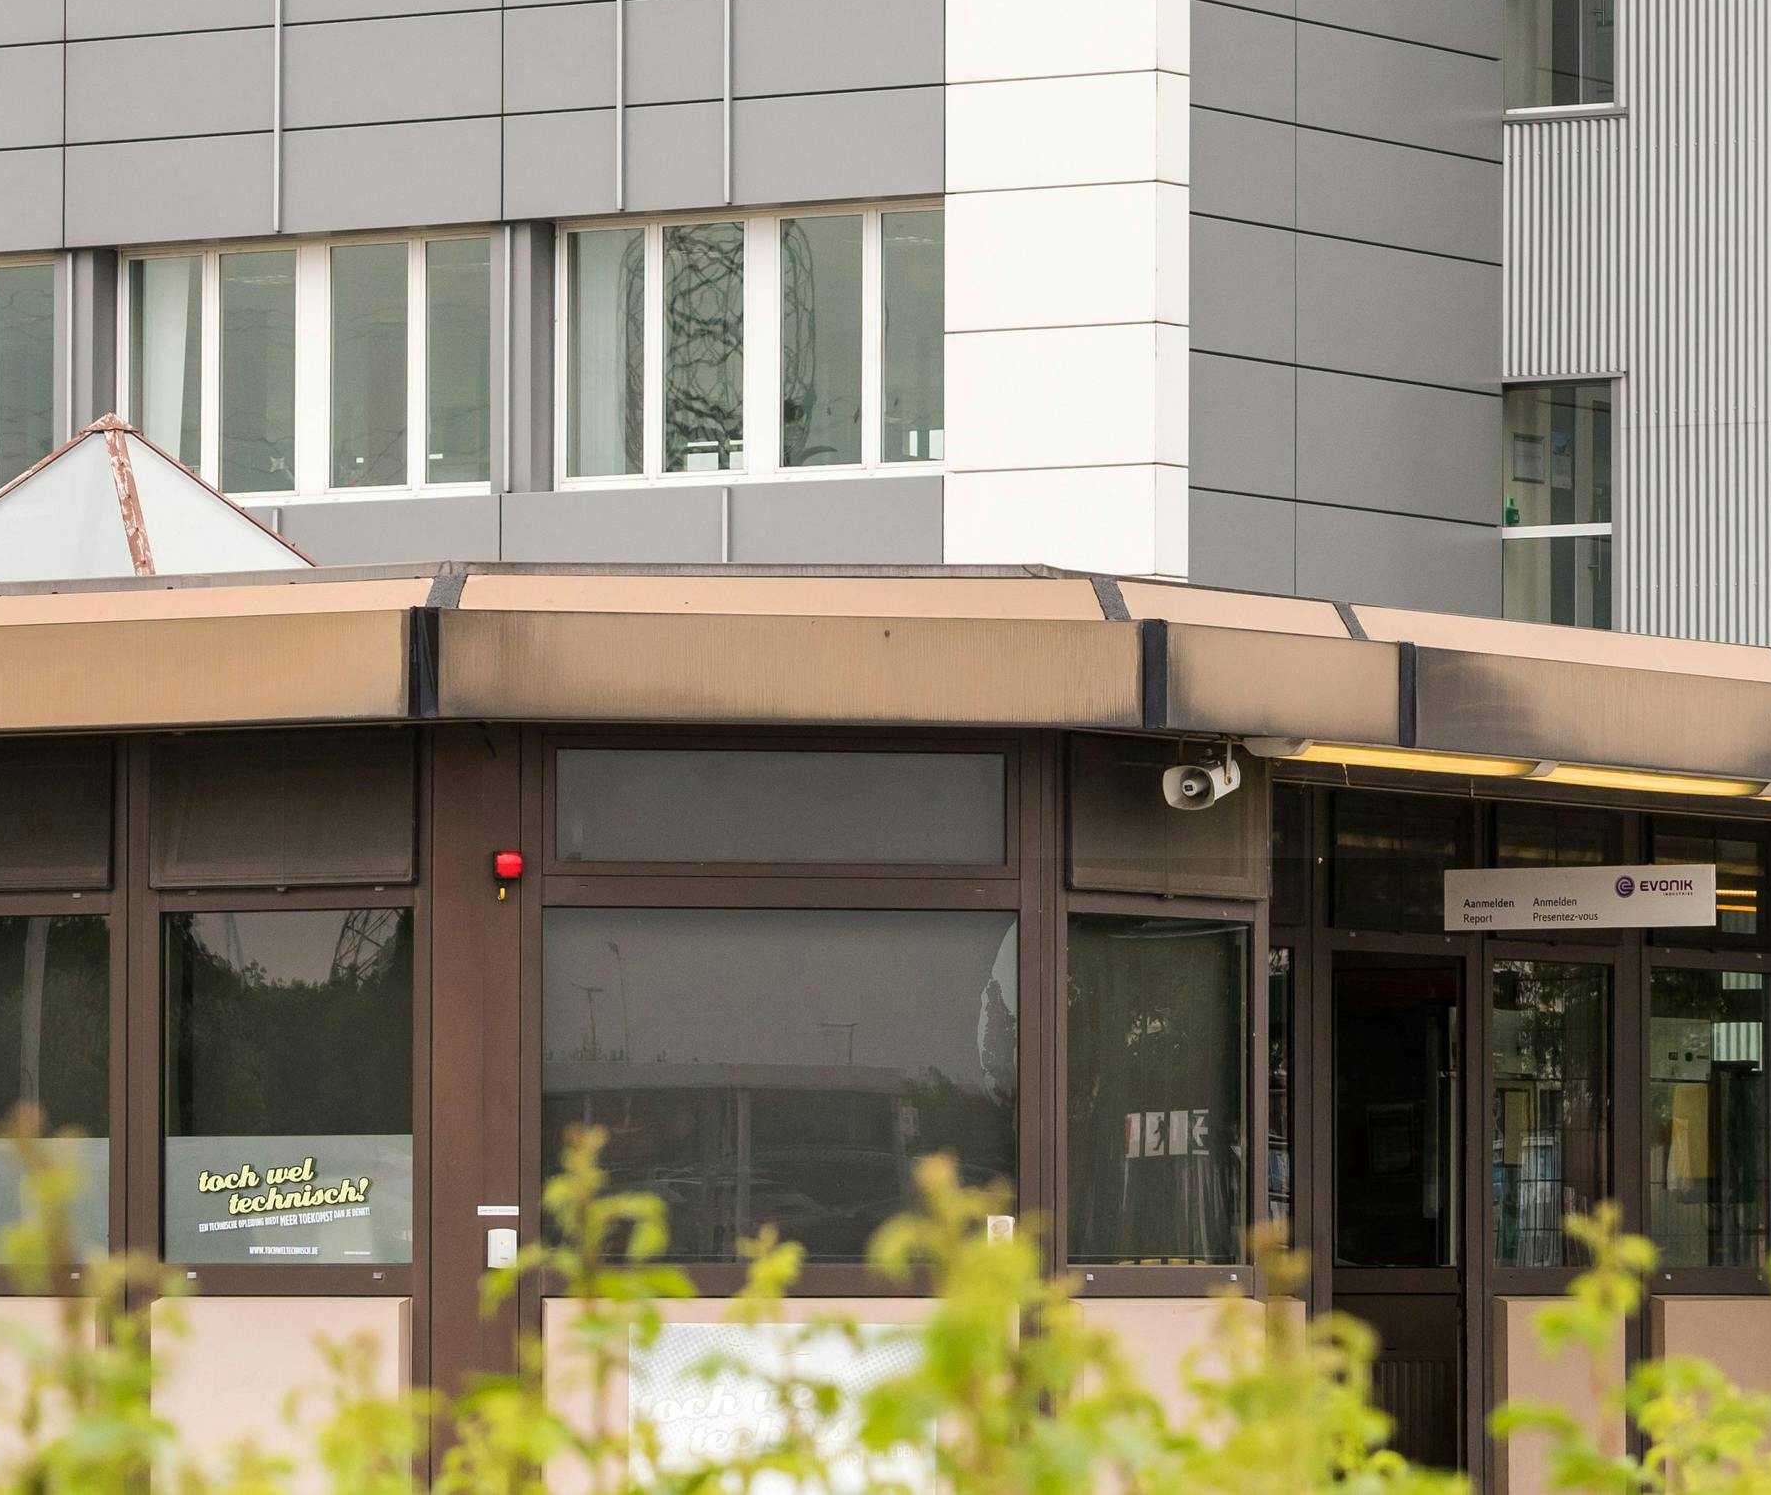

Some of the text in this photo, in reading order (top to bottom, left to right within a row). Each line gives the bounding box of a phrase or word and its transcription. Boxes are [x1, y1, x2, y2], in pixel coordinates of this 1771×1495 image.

[1640, 879, 1693, 891] EVONIK
[1463, 898, 1515, 908] Aanmelden
[1532, 896, 1577, 907] Anmelden
[1463, 914, 1493, 925] Report
[1532, 912, 1598, 922] Presentez-vous
[198, 1157, 314, 1192] toch wel
[229, 1177, 370, 1214] technisch!
[280, 1214, 298, 1227] MEER
[298, 1210, 333, 1225] TOEKOMST
[333, 1208, 345, 1219] DAN
[345, 1207, 352, 1218] JE
